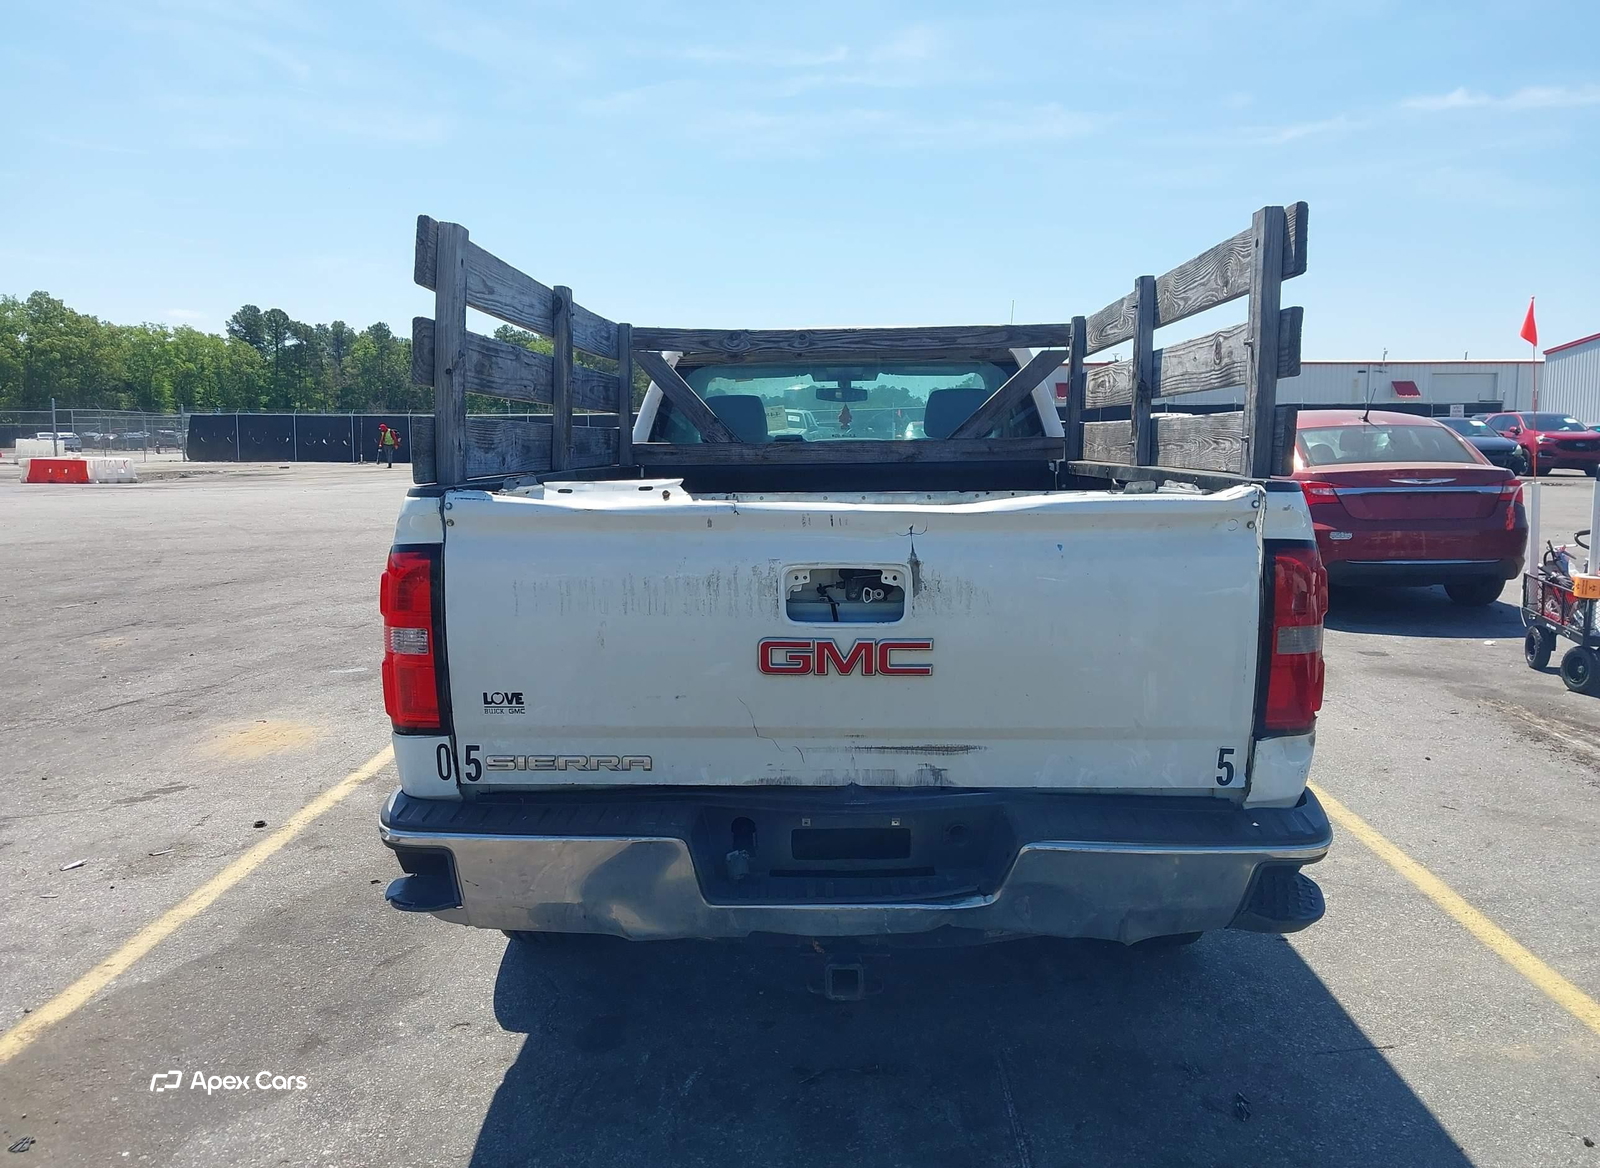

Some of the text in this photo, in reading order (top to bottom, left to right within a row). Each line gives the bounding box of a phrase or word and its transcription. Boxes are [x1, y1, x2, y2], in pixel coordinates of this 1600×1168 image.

[757, 636, 934, 676] GMC
[482, 691, 525, 706] LOVE
[485, 754, 653, 772] SIERRA
[1216, 748, 1235, 787] 5
